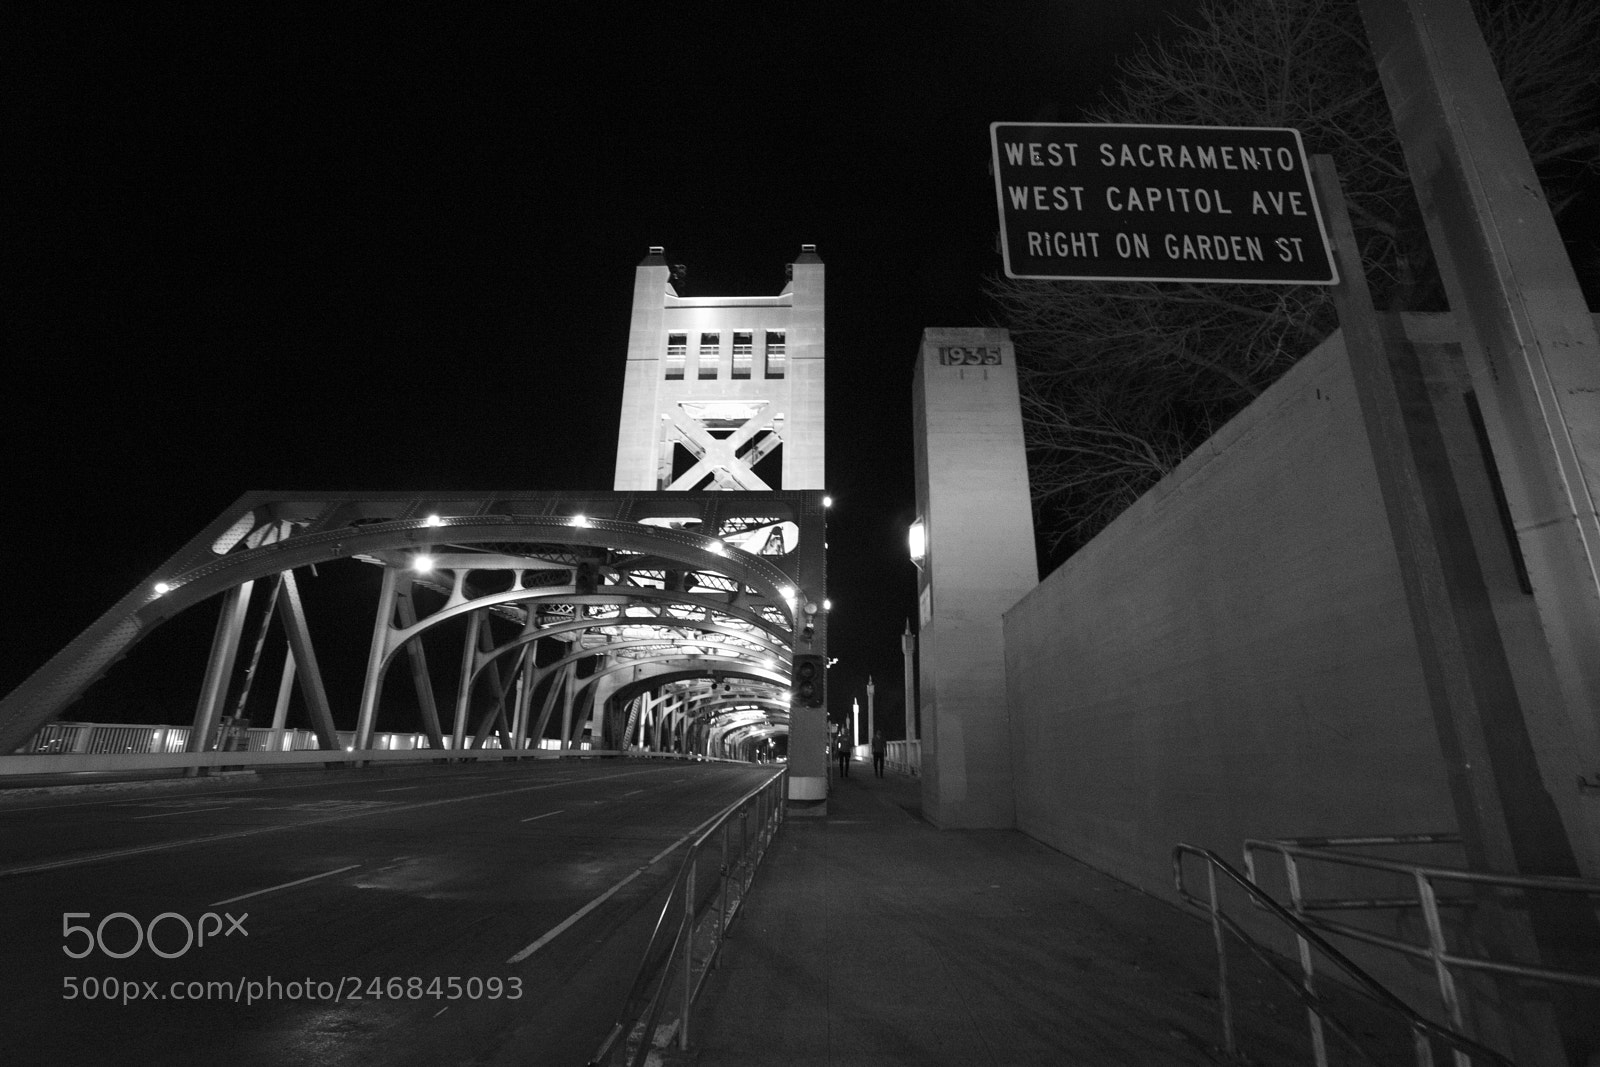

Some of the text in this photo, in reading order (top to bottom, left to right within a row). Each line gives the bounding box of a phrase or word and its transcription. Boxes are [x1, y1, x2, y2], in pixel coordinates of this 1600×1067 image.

[1004, 142, 1294, 171] WEST SACRAMENTO
[1008, 186, 1307, 216] WEST CAPITOL AVE
[1027, 231, 1305, 262] RIGHT ON GARDEN ST
[942, 347, 1000, 365] 1935
